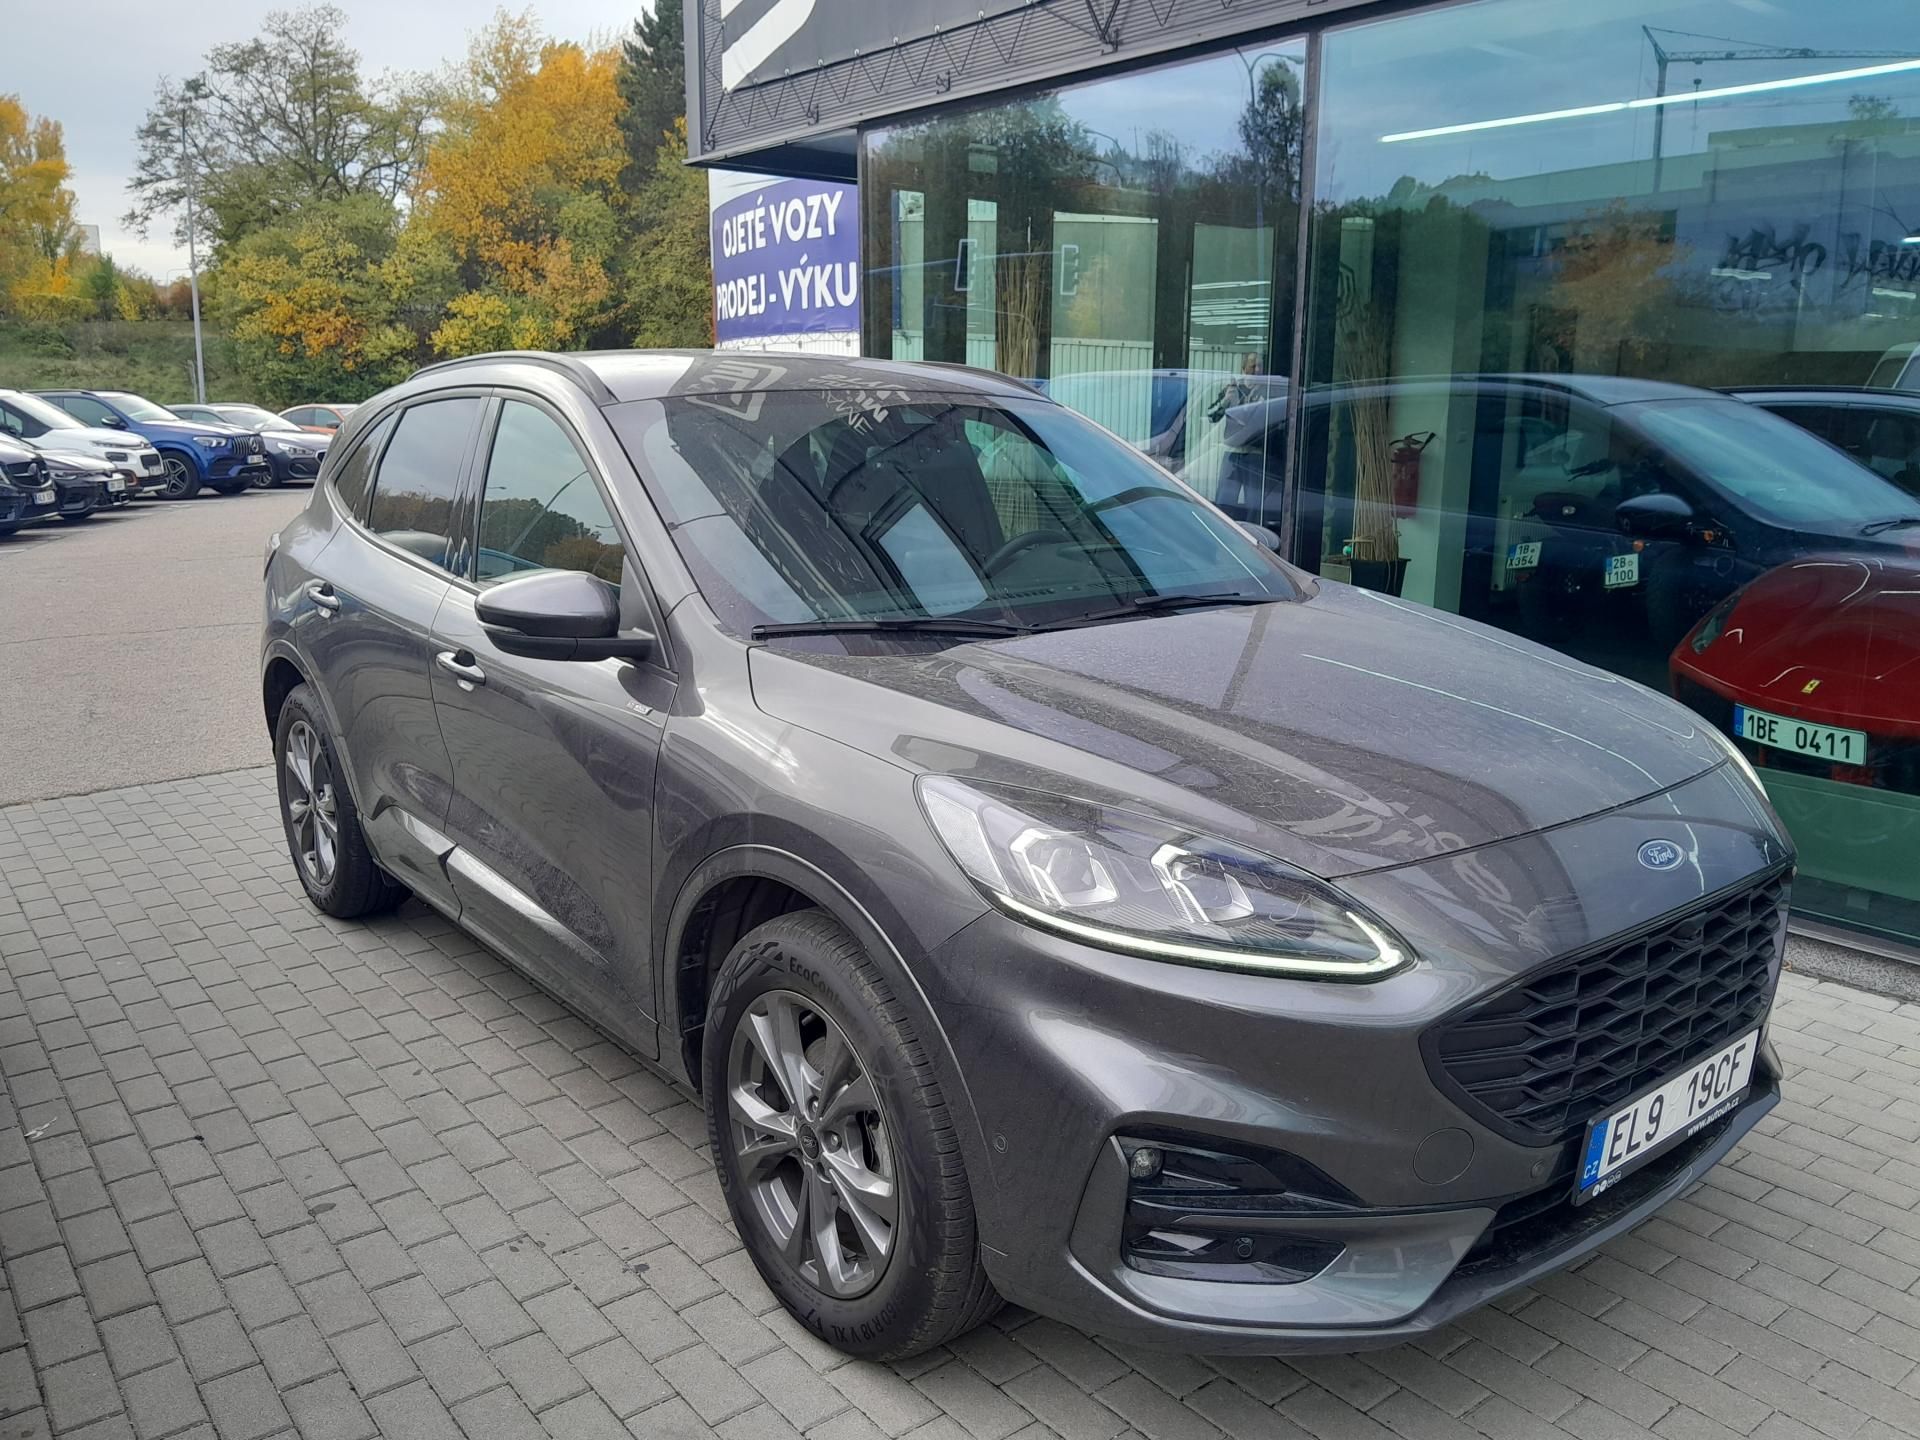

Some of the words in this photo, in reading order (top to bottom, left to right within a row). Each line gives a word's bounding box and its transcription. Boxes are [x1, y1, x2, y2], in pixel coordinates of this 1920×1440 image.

[722, 194, 766, 258] OJETÉ
[769, 191, 843, 245] VOZY
[717, 273, 766, 321] PRODEJ
[1613, 557, 1626, 569] 2B
[1747, 714, 1779, 743] 1BE
[1795, 726, 1851, 759] 0411
[1647, 846, 1675, 865] Ford
[1607, 1094, 1665, 1167] EL9
[1687, 1042, 1747, 1117] 19CF
[1583, 1160, 1599, 1179] CZ
